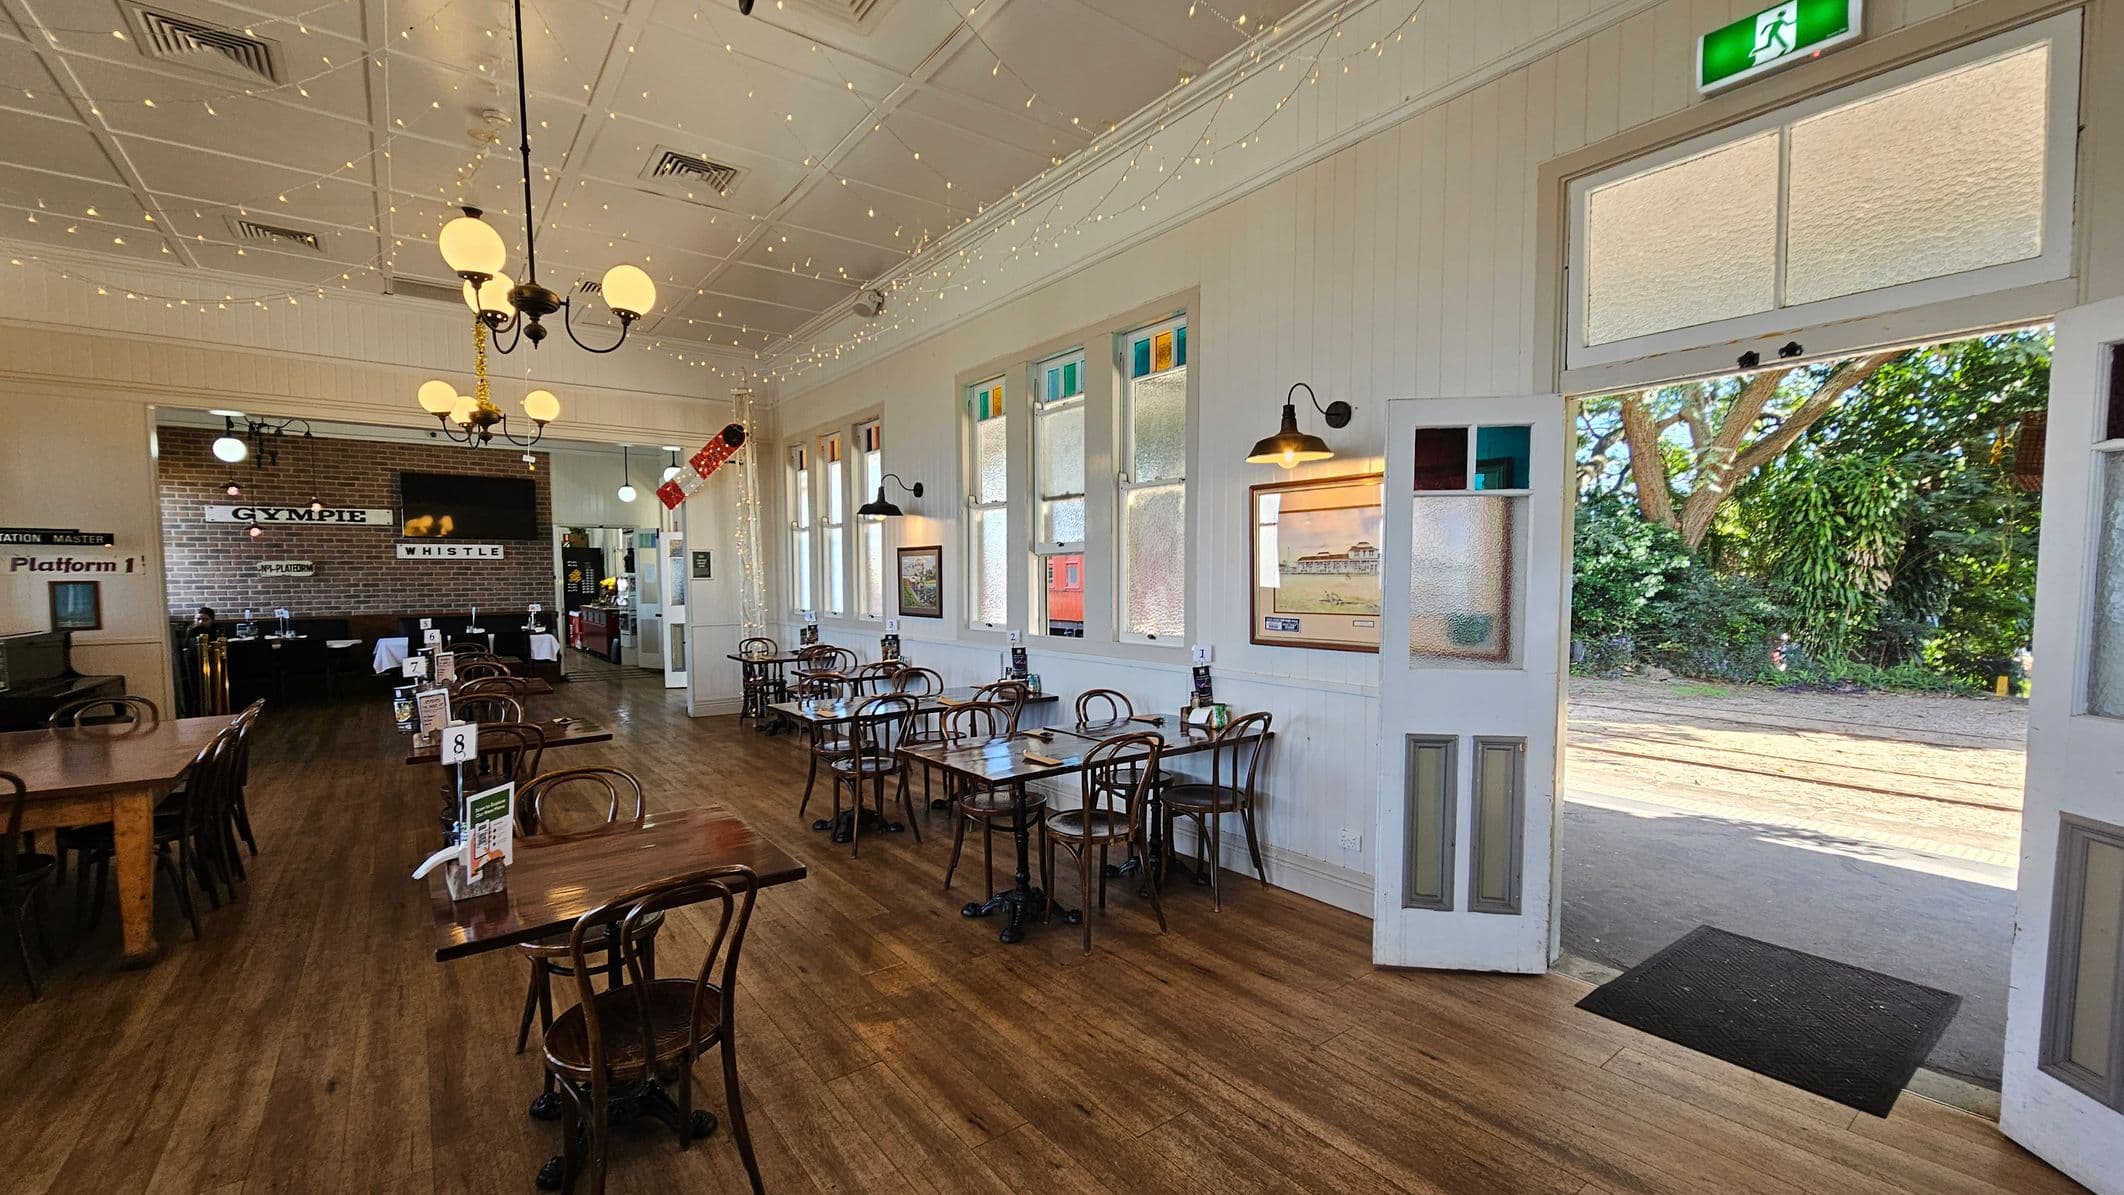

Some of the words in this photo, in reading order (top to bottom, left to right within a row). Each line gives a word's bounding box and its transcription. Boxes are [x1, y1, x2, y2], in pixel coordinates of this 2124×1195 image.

[232, 507, 366, 523] GYMPIE
[53, 534, 104, 543] MASTER
[405, 546, 500, 556] WHISTLE
[10, 557, 117, 573] Platform
[125, 557, 134, 573] 1
[429, 632, 435, 640] 6
[1200, 649, 1204, 658] 1
[410, 661, 418, 672] 7
[454, 734, 464, 753] 8
